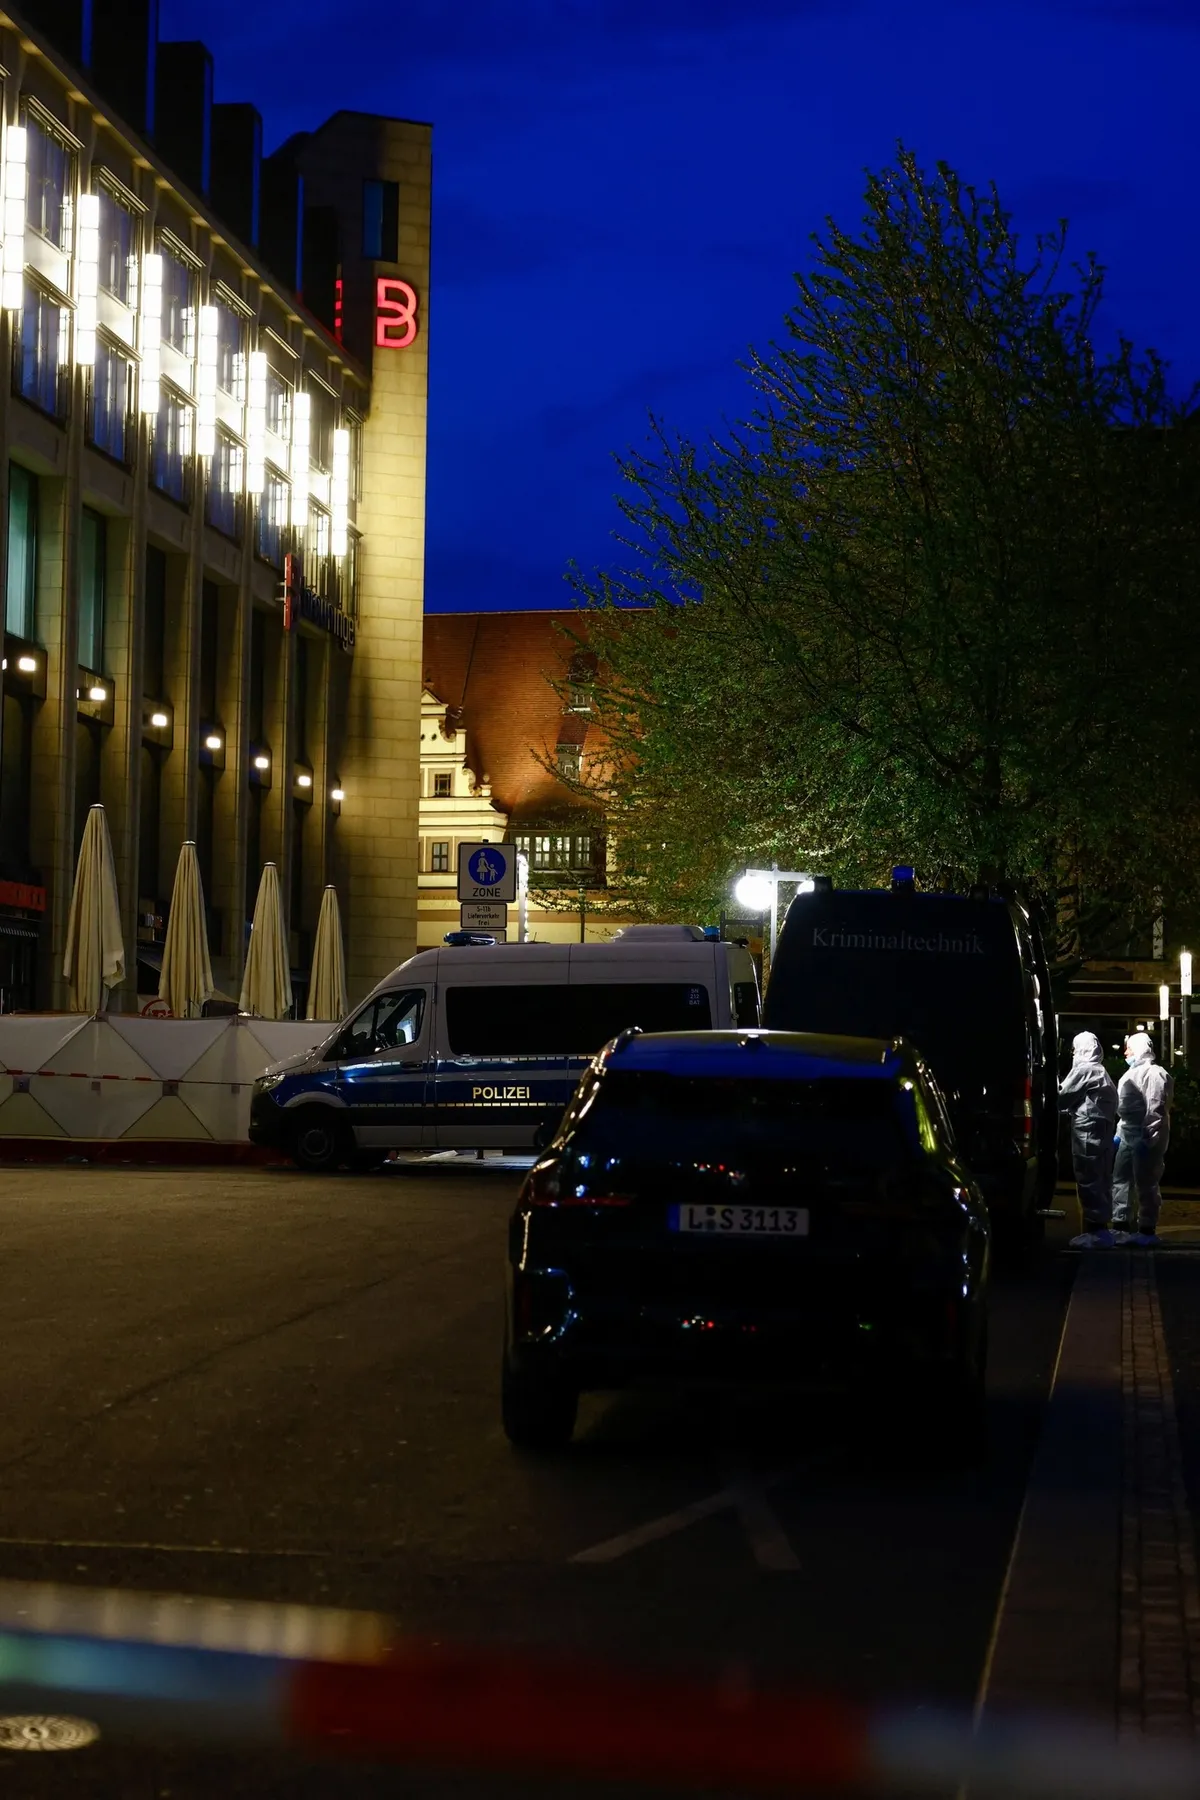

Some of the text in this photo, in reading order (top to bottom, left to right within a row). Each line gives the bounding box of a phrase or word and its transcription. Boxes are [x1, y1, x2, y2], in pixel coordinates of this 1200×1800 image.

[376, 277, 418, 348] B
[472, 887, 501, 897] ZONE
[811, 927, 986, 955] Kriminaltechnik
[472, 1086, 530, 1099] POLIZEI
[739, 1209, 797, 1231] 3113
